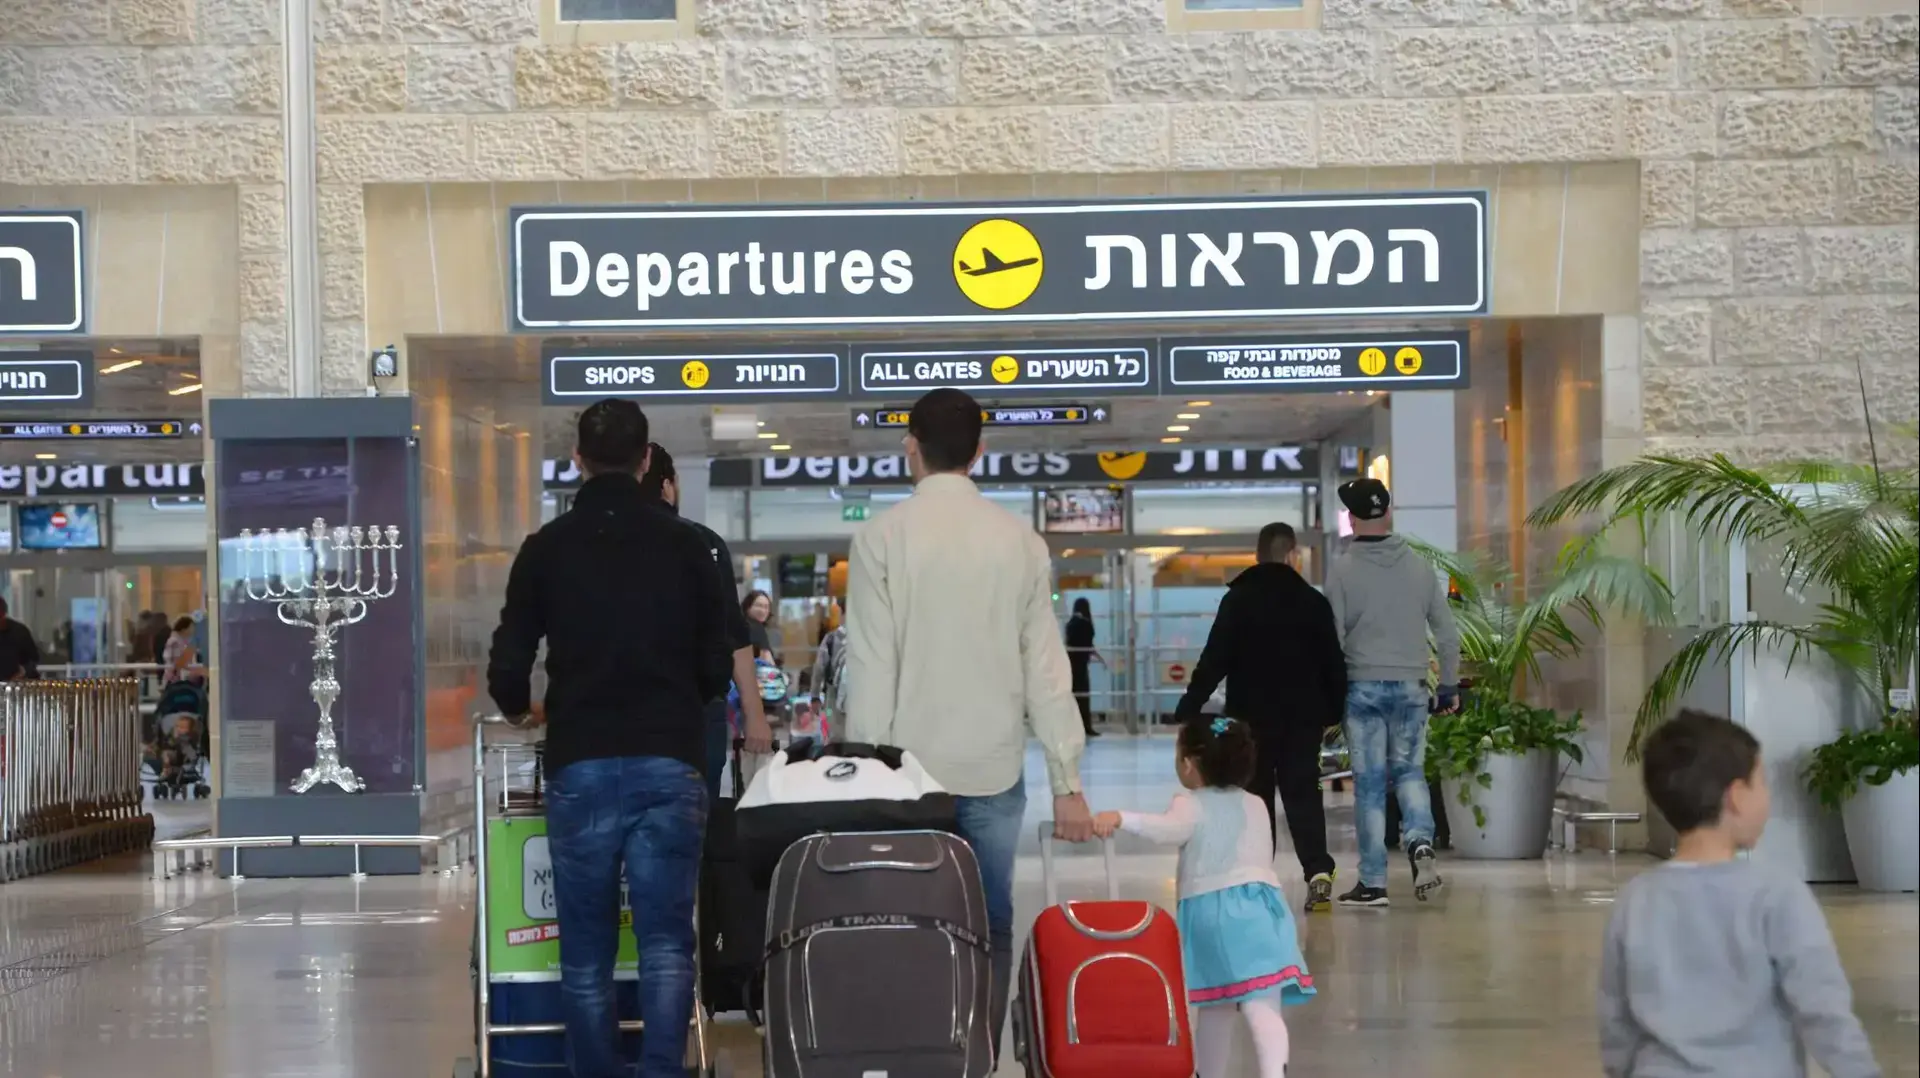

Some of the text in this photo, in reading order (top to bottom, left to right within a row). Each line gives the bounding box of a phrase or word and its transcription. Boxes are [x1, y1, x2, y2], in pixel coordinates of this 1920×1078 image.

[1085, 228, 1440, 290] המראות
[549, 241, 914, 311] Departures
[1206, 348, 1342, 366] מסעדות ובתי קפה
[585, 366, 655, 384] SHOPS
[736, 365, 806, 382] חנויות
[870, 361, 983, 380] ALL GATES
[1027, 355, 1140, 379] כל השערים
[1223, 364, 1342, 379] FOOD & BEVERAGE
[0, 371, 47, 389] חנוי
[14, 424, 63, 434] ALL GATES
[134, 423, 147, 433] כל
[841, 914, 915, 926] TRAVEL
